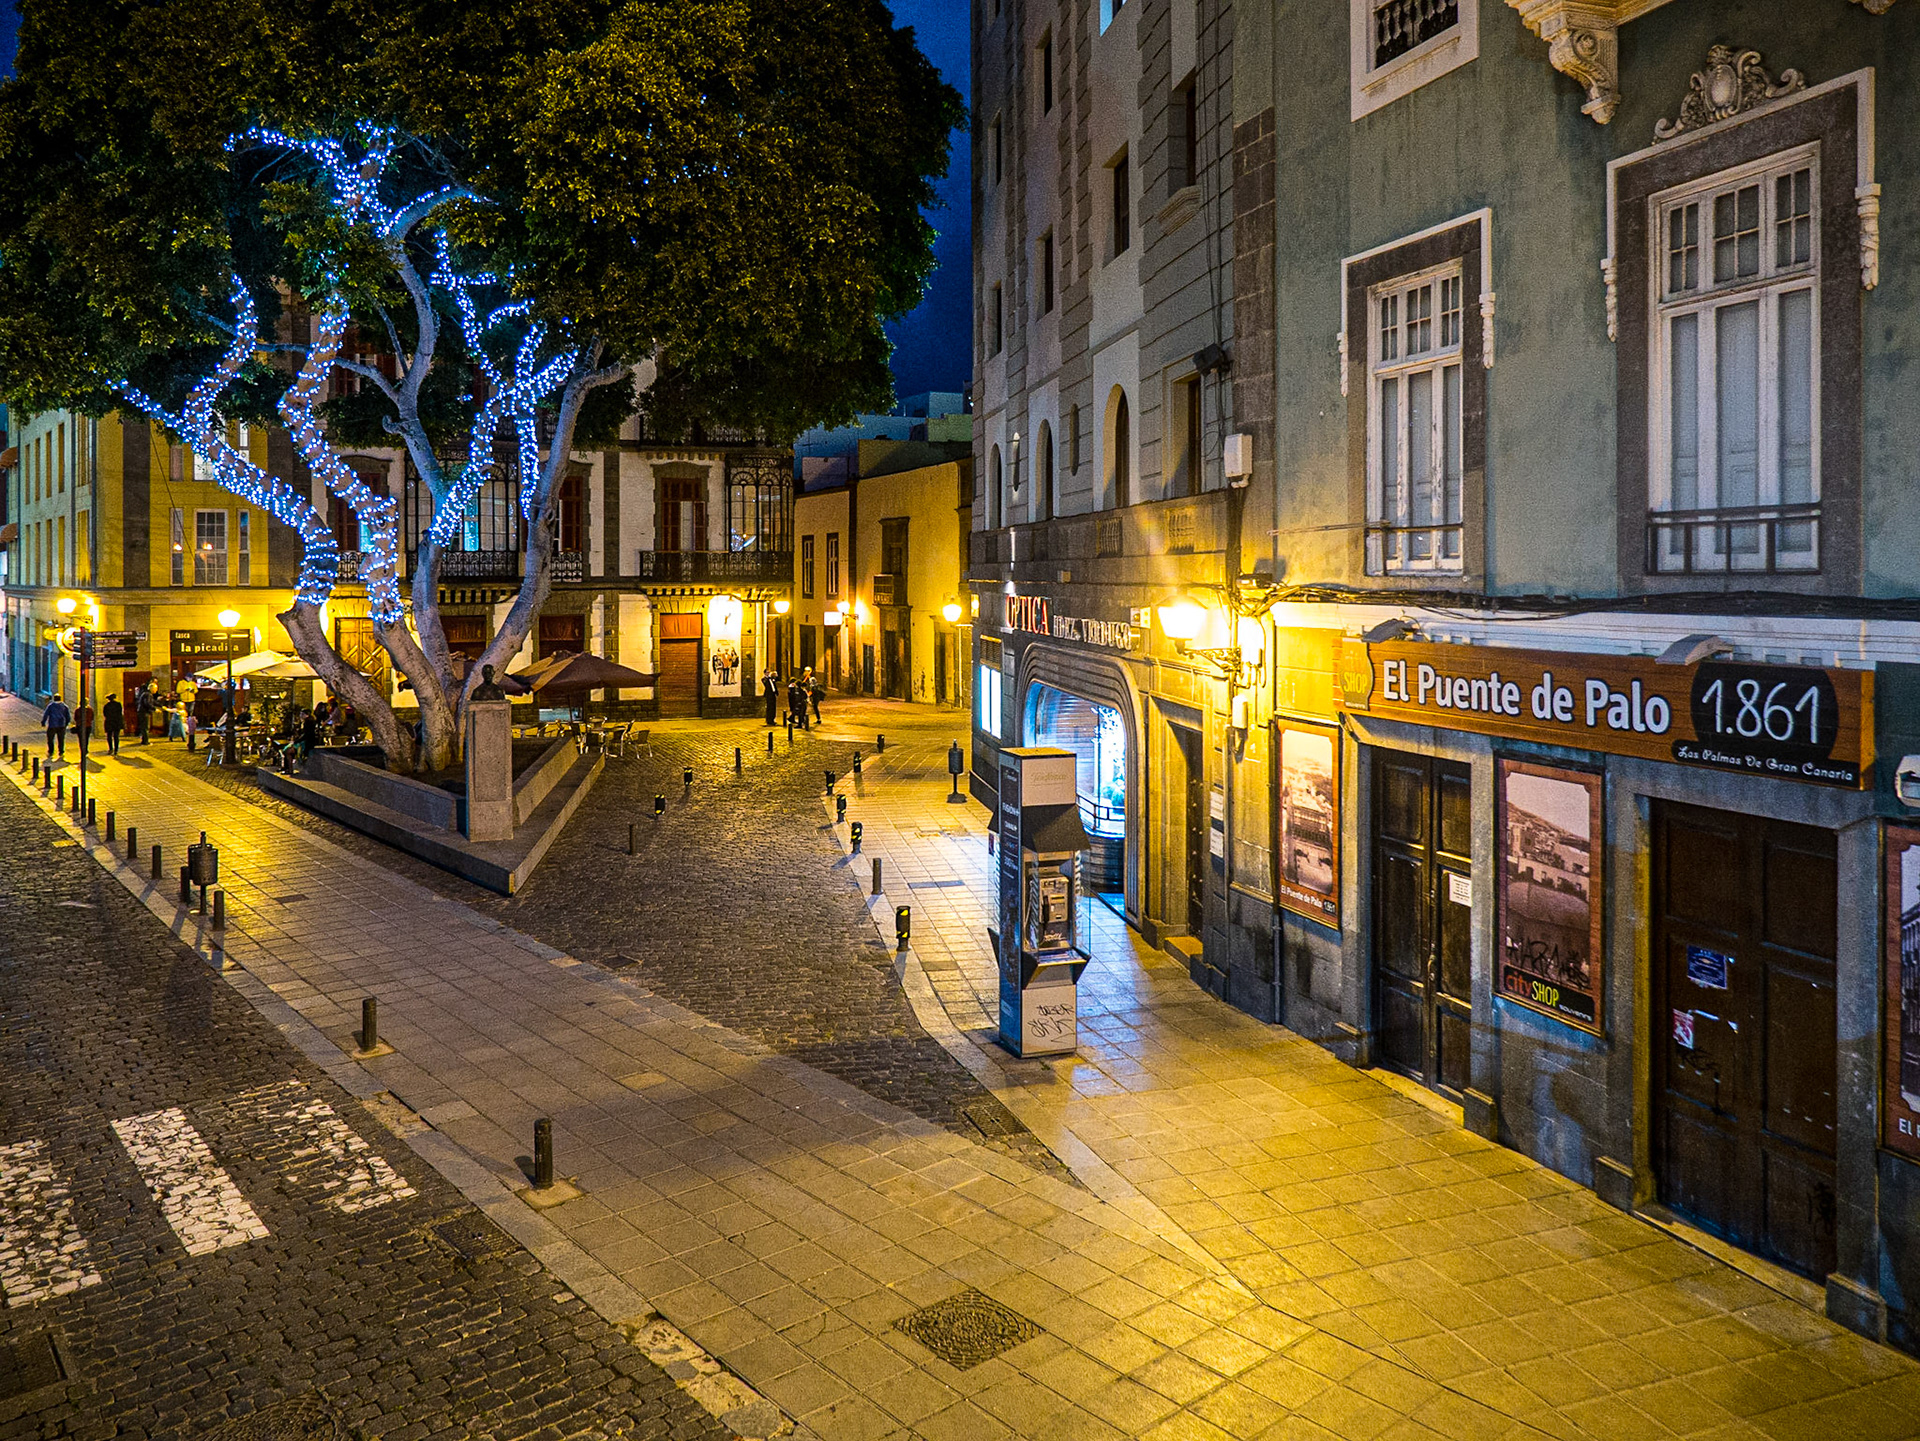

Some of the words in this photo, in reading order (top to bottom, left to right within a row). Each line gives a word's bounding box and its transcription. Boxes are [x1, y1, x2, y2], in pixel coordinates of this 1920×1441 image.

[180, 642, 192, 653] la
[194, 641, 239, 653] picadia
[1343, 671, 1367, 695] SHOP
[1383, 659, 1410, 702] El
[1417, 664, 1520, 716] Puente
[1531, 672, 1573, 722] de
[1585, 679, 1670, 734] Palo
[1702, 679, 1819, 744] 1.861
[1678, 746, 1699, 759] Las
[1702, 749, 1741, 766] Palmas
[1745, 755, 1762, 768] De
[1766, 757, 1798, 774] Gran
[1802, 762, 1853, 782] Canaria
[1898, 1117, 1913, 1136] El
